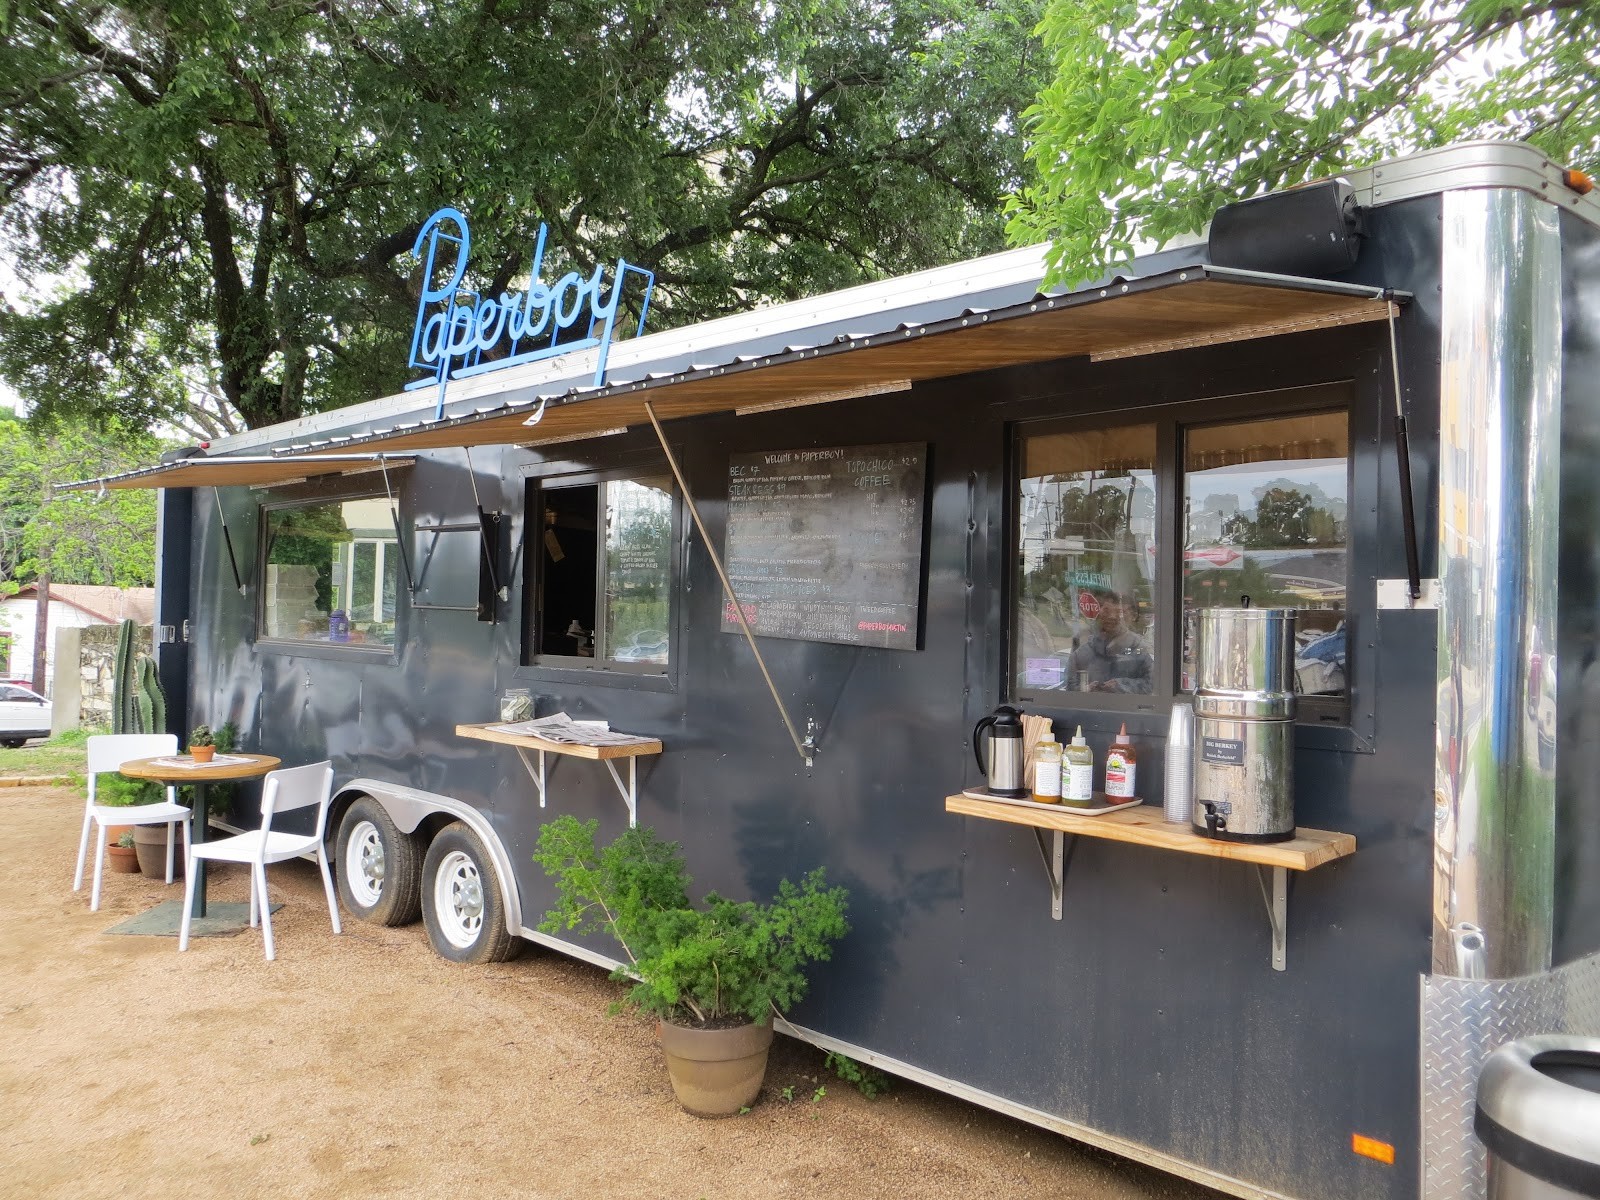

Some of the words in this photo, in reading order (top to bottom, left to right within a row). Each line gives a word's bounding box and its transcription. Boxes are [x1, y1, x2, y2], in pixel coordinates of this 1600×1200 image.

[408, 207, 626, 420] Paperboy
[730, 466, 746, 476] BEC
[854, 474, 891, 488] COFFEE
[729, 484, 750, 496] STEAK
